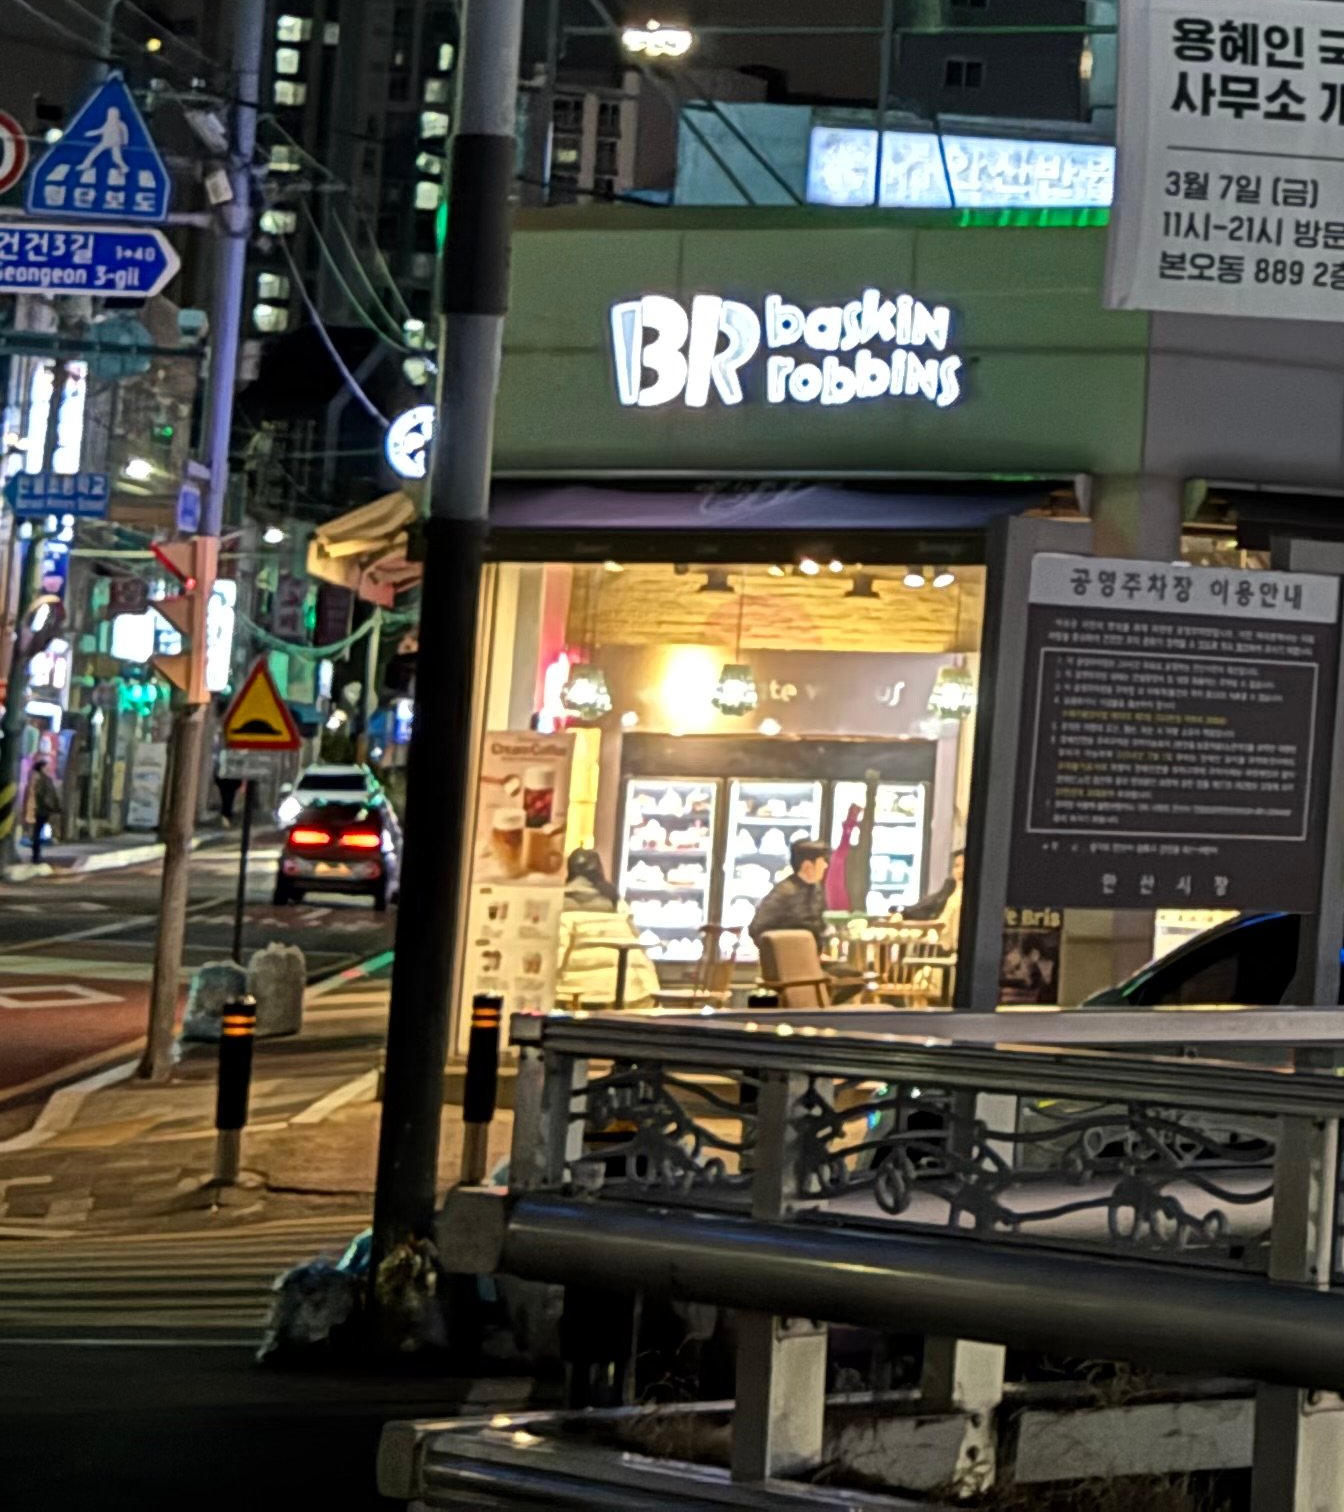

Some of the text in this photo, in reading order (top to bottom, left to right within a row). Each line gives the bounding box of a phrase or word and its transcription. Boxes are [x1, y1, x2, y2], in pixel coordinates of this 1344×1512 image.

[1172, 18, 1305, 70] 용혜인
[1170, 72, 1306, 122] 사무소
[1165, 171, 1319, 208] 3월 7일 (금)
[1161, 211, 1283, 246] 11시-21시
[94, 264, 140, 289] 3-gil
[1158, 251, 1245, 284] 본오동
[1253, 257, 1305, 285] 889
[611, 295, 761, 407] BR
[1070, 568, 1302, 611] 공영주차장 이용안내
